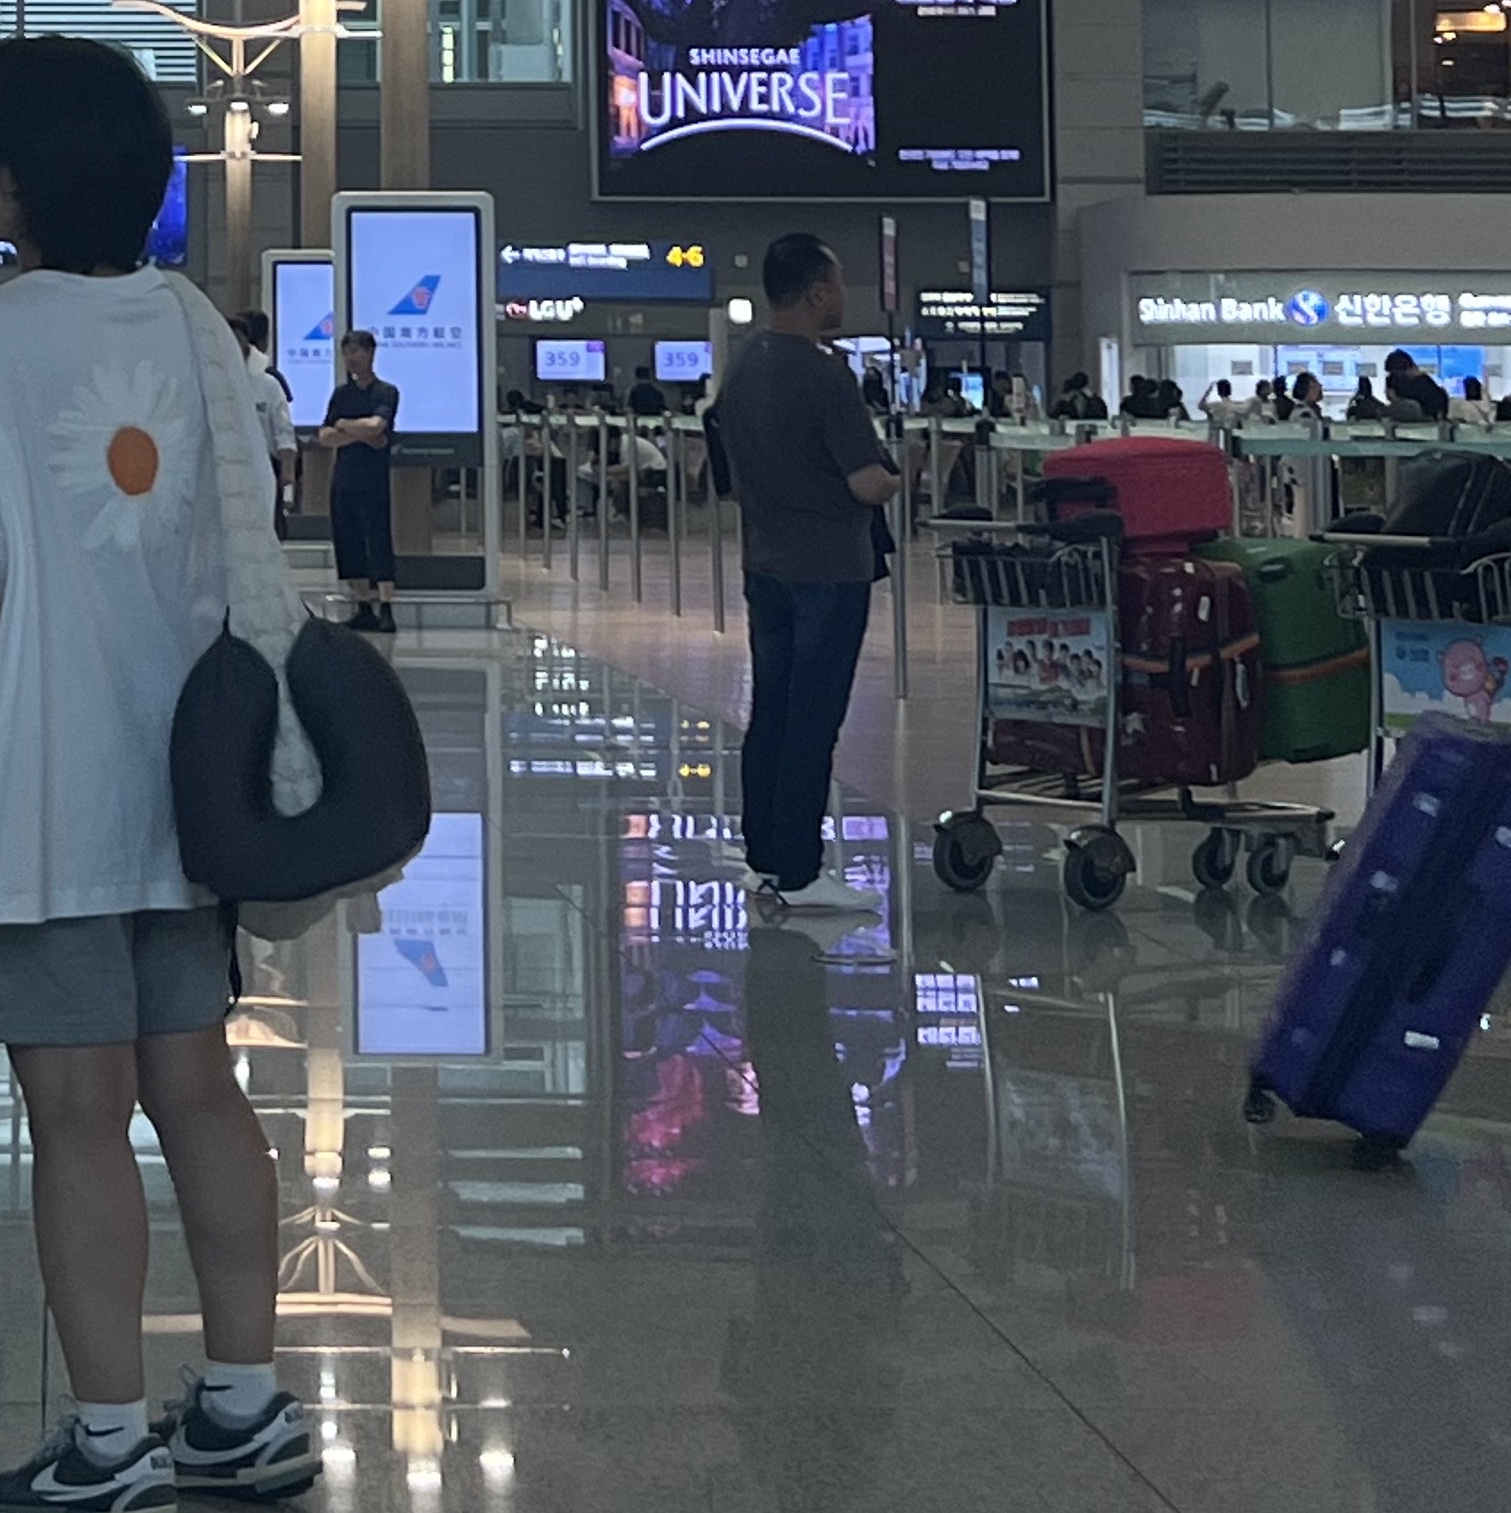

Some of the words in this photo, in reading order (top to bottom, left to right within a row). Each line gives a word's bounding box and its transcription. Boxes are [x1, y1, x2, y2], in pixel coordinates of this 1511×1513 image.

[689, 48, 801, 65] SHINSEGAE
[639, 71, 851, 126] UNIVERSE
[1138, 298, 1216, 324] Shinhan
[1220, 297, 1286, 323] Bank
[1335, 293, 1452, 327] 신한은행
[544, 351, 581, 368] 359
[663, 351, 699, 368] 359
